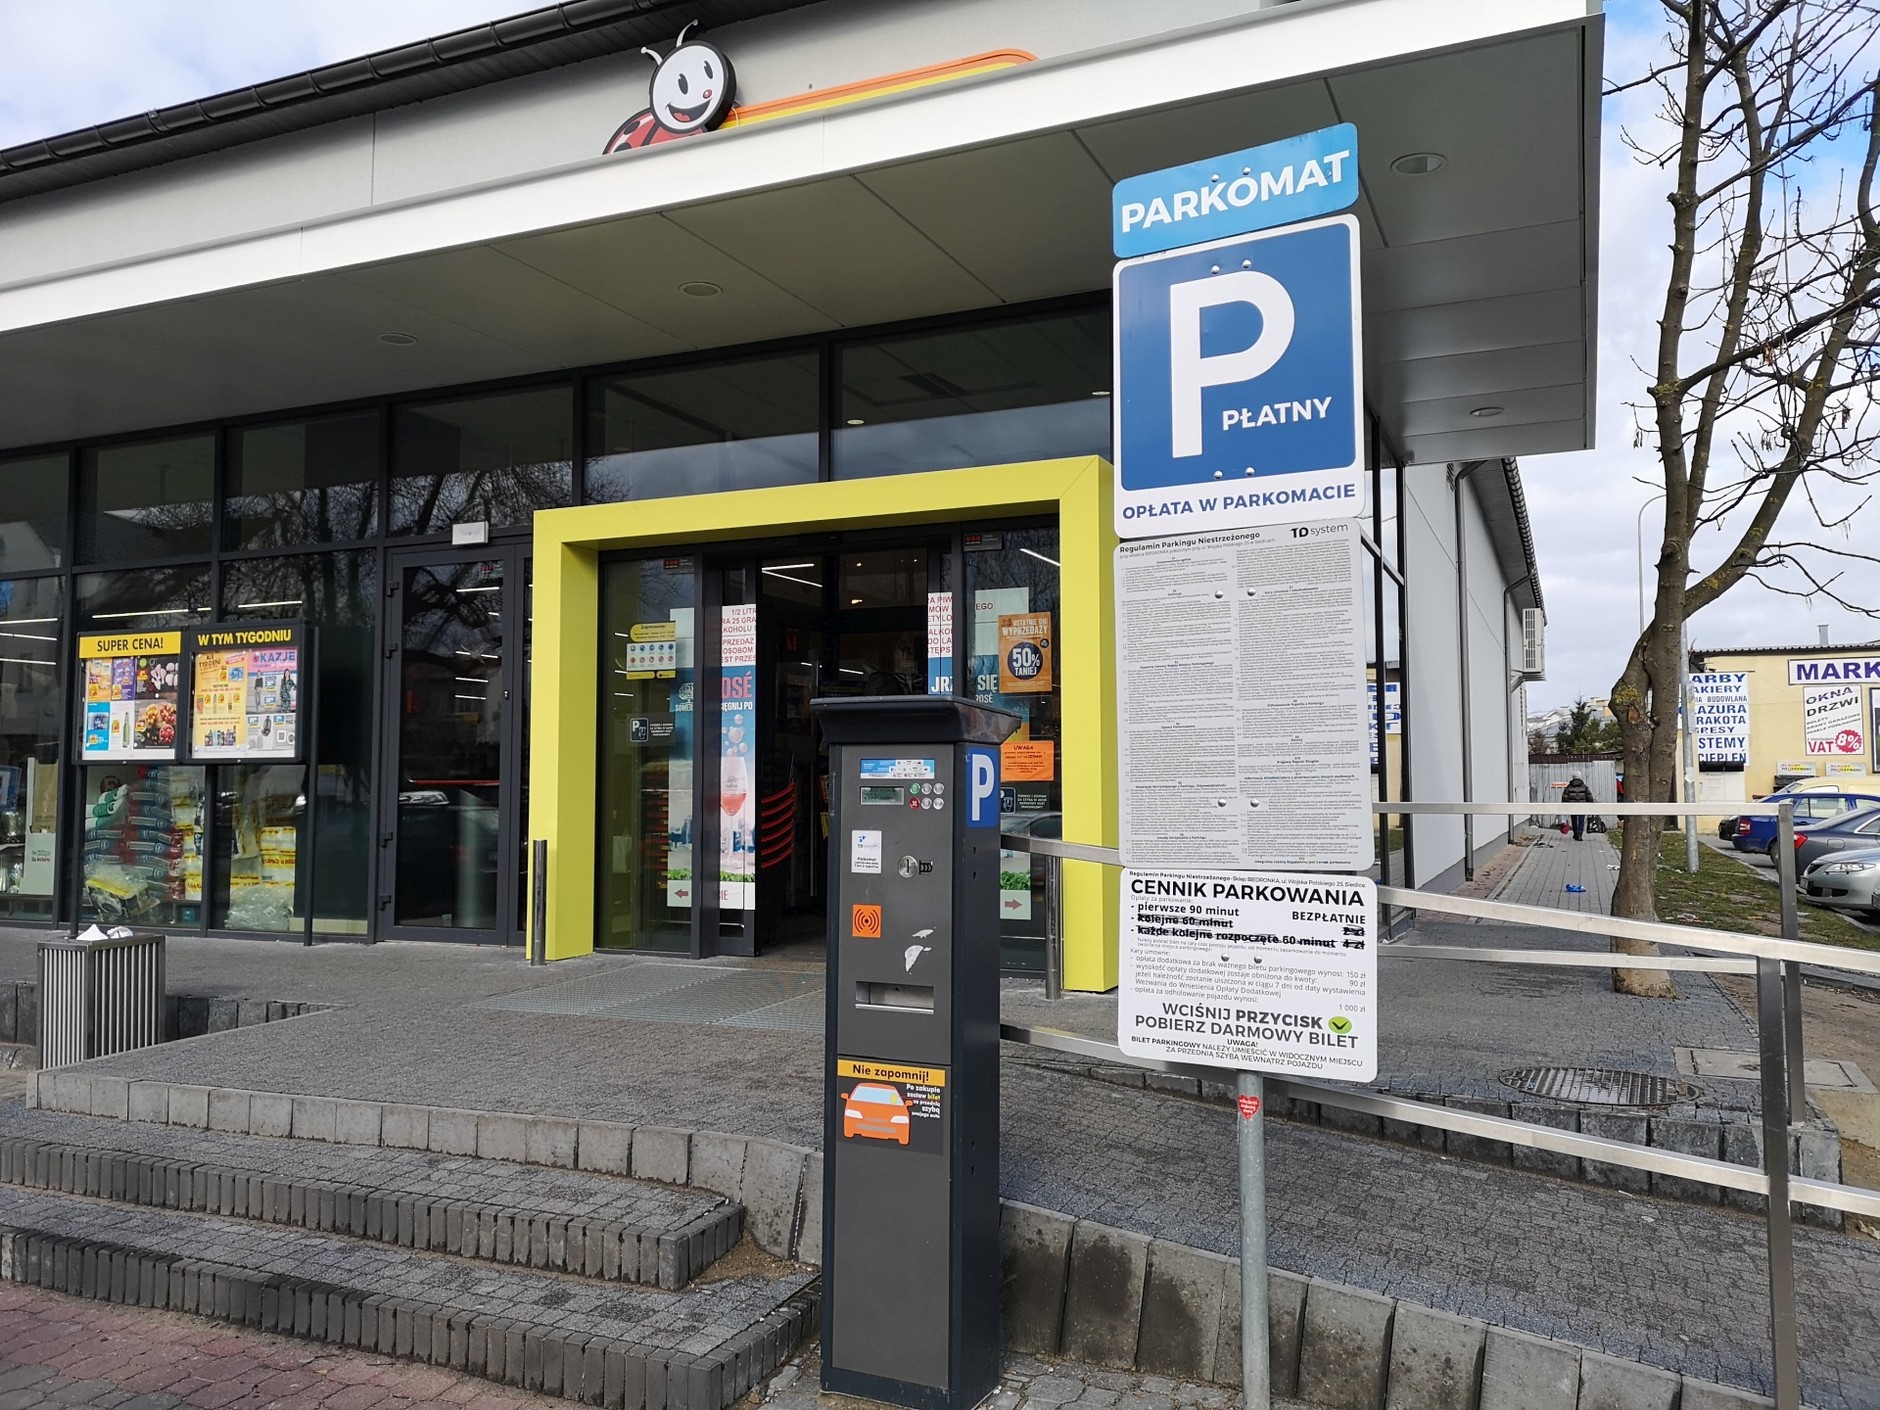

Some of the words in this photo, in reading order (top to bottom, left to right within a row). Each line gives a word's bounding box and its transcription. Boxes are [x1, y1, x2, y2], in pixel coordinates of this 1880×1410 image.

[1121, 149, 1350, 234] PARKOMAT
[1169, 270, 1295, 459] P
[1222, 397, 1332, 431] PŁATNY
[1122, 501, 1194, 520] OPŁATA
[1199, 497, 1219, 512] W
[1223, 483, 1356, 510] PARKOMACIE
[1310, 524, 1348, 536] system
[1120, 542, 1160, 553] Regulamin
[1162, 538, 1196, 548] Parkingu
[1199, 532, 1260, 544] Niestrzeżonego
[97, 640, 128, 652] SUPER
[132, 637, 163, 650] CENA!
[198, 634, 210, 646] W
[211, 633, 234, 645] TYM
[236, 629, 292, 643] TYGODNIU
[1012, 647, 1040, 667] 50%
[1015, 667, 1037, 676] TANIEJ
[1692, 674, 1746, 683] ARBY
[977, 675, 998, 693] SIĘ
[1806, 687, 1853, 704] OKNA
[744, 702, 752, 710] PO
[1695, 705, 1747, 714] AZURA
[1807, 697, 1858, 717] DRZWI
[632, 720, 640, 732] P
[1697, 716, 1746, 725] RAKOTA
[1808, 741, 1833, 753] VAT
[1837, 733, 1859, 750] 8%
[971, 754, 994, 821] P
[1131, 879, 1207, 898] CENNIK
[1213, 883, 1364, 906] PARKOWANIA
[1138, 902, 1186, 913] pierwsze
[1190, 905, 1202, 914] 90
[1206, 906, 1239, 916] minut
[1292, 911, 1366, 924] BEZPŁATNIE
[1157, 957, 1191, 965] dodatkowa
[1269, 966, 1316, 975] parkingowego
[1189, 967, 1225, 977] dodatkowej
[1153, 972, 1184, 980] należność
[1305, 985, 1321, 993] daty
[1322, 986, 1366, 996] wystawienia
[1179, 982, 1214, 990] Wniesienia
[1216, 985, 1239, 994] Opłaty
[1241, 986, 1281, 998] Dodatkowej
[1207, 992, 1232, 1000] pojazdu
[1162, 1002, 1231, 1021] WCIŚNIJ
[1236, 1009, 1323, 1029] PRZYCISK
[1136, 1015, 1206, 1033] POBIERZ
[1211, 1022, 1304, 1043] DARMOWY
[1309, 1032, 1358, 1048] BILET
[1152, 1038, 1201, 1049] PARKINGOWY
[1202, 1043, 1230, 1052] NALEŻY
[1232, 1045, 1267, 1056] UMIEŚCIĆ
[1279, 1051, 1328, 1063] WIDOCZNYM
[1329, 1058, 1363, 1067] MIEJSCU
[1227, 1039, 1258, 1048] UWAGA!
[1178, 1047, 1214, 1059] PRZEDNIĄ
[1216, 1052, 1239, 1061] SZYBĄ
[1241, 1054, 1285, 1065] WEWNĄTRZ
[1287, 1059, 1323, 1069] POJAZDU
[853, 1064, 871, 1075] Nie
[874, 1066, 929, 1083] zapomnij!
[922, 1106, 940, 1114] szybą
